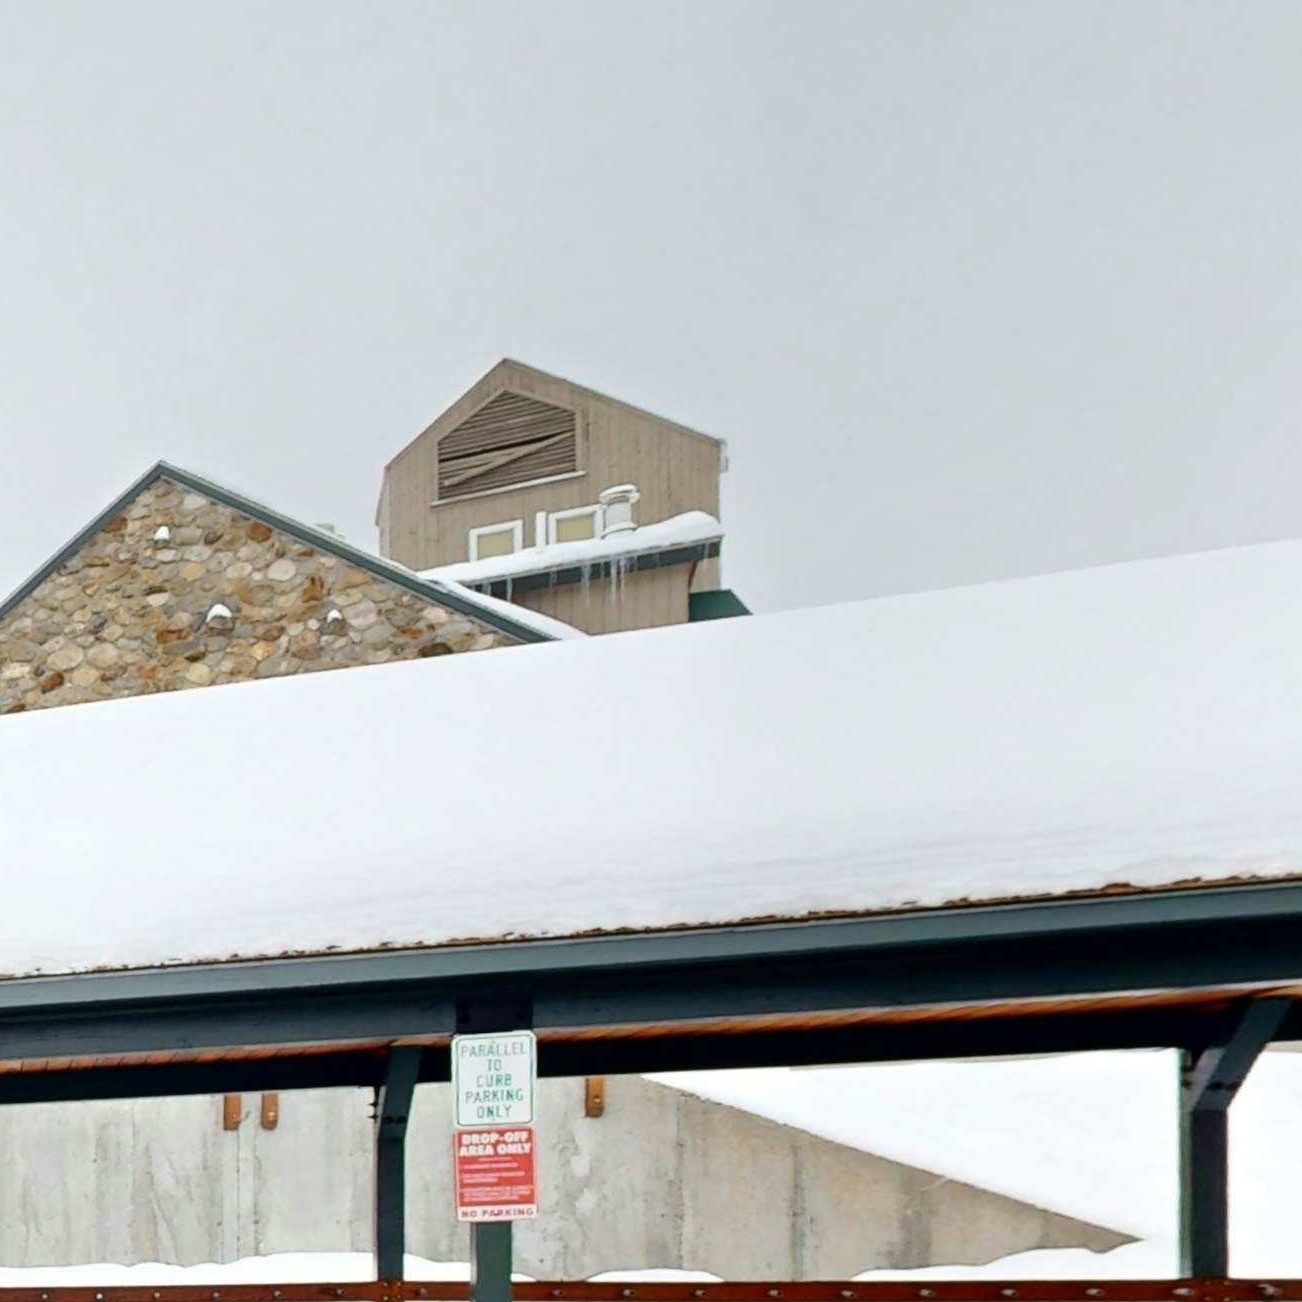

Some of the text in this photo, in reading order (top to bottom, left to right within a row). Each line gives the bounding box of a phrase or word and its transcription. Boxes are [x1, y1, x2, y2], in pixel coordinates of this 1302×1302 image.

[460, 1042, 526, 1058] PARALLEL
[487, 1058, 502, 1072] TO
[476, 1074, 512, 1088] CURB
[465, 1088, 524, 1104] PARKING
[476, 1105, 511, 1119] ONLY
[461, 1131, 529, 1144] DROP-OFF
[459, 1142, 532, 1157] AREA ONLY
[461, 1207, 534, 1218] NO PARKING
